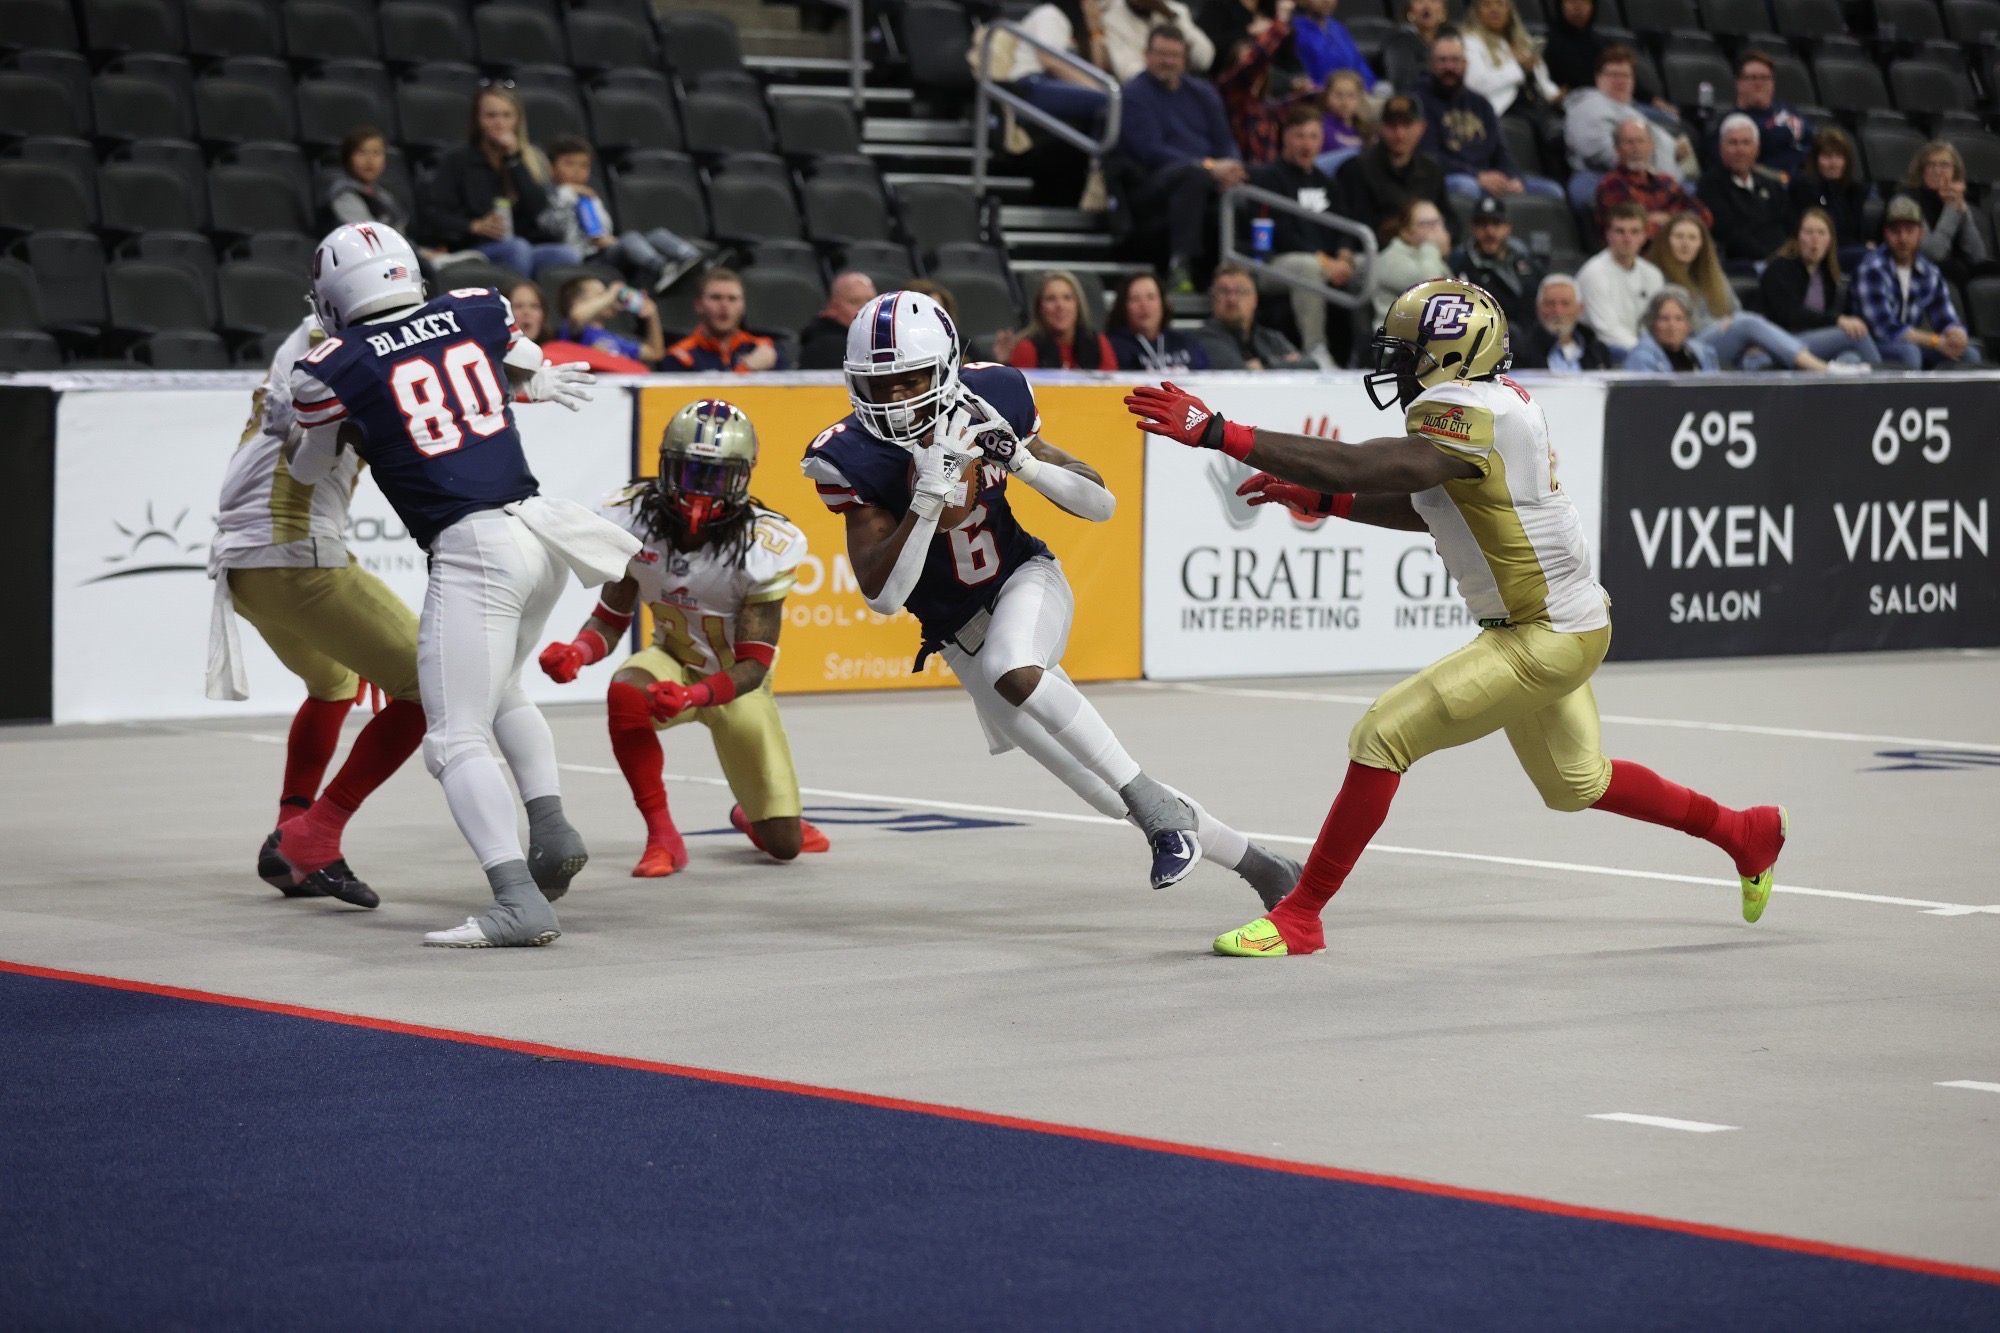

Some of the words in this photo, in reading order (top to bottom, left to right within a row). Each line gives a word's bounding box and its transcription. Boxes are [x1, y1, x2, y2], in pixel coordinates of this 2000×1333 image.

[366, 311, 462, 357] BLAKEY
[390, 339, 509, 458] 80
[811, 422, 848, 450] 6
[1184, 412, 1209, 431] adidas
[1422, 415, 1448, 430] QUAD
[1450, 420, 1472, 435] CITY
[948, 501, 1001, 587] 6
[1630, 504, 1794, 570] VIXEN
[1833, 498, 1989, 564] VIXEN
[1181, 546, 1363, 601] GRATE
[1181, 607, 1360, 631] INTERPRETING
[1669, 590, 1761, 624] SALON
[1869, 582, 1957, 616] SALON
[649, 601, 737, 671] 21
[823, 652, 914, 682] Serious
